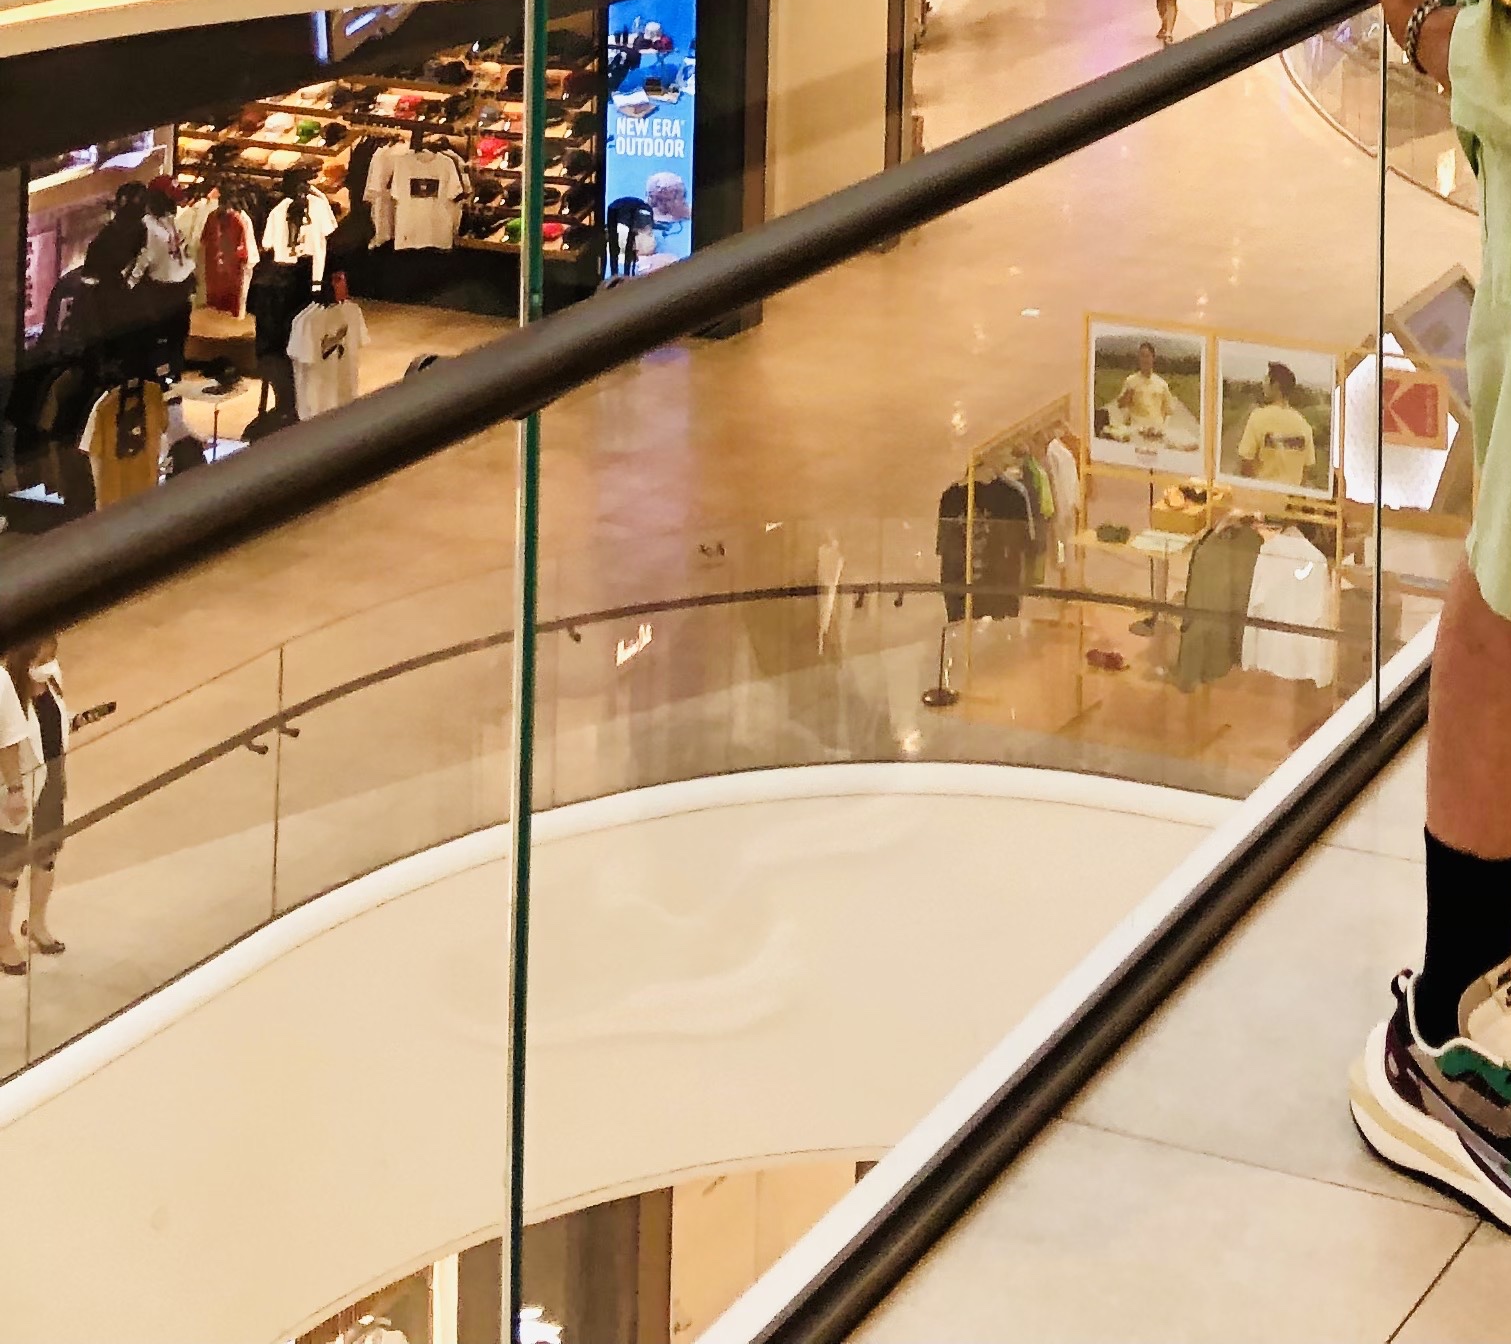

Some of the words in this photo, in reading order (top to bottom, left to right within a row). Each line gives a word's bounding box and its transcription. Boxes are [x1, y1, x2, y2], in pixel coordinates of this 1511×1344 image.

[616, 117, 650, 137] NEW
[652, 118, 681, 139] ERA
[615, 136, 685, 159] OUTDOOR
